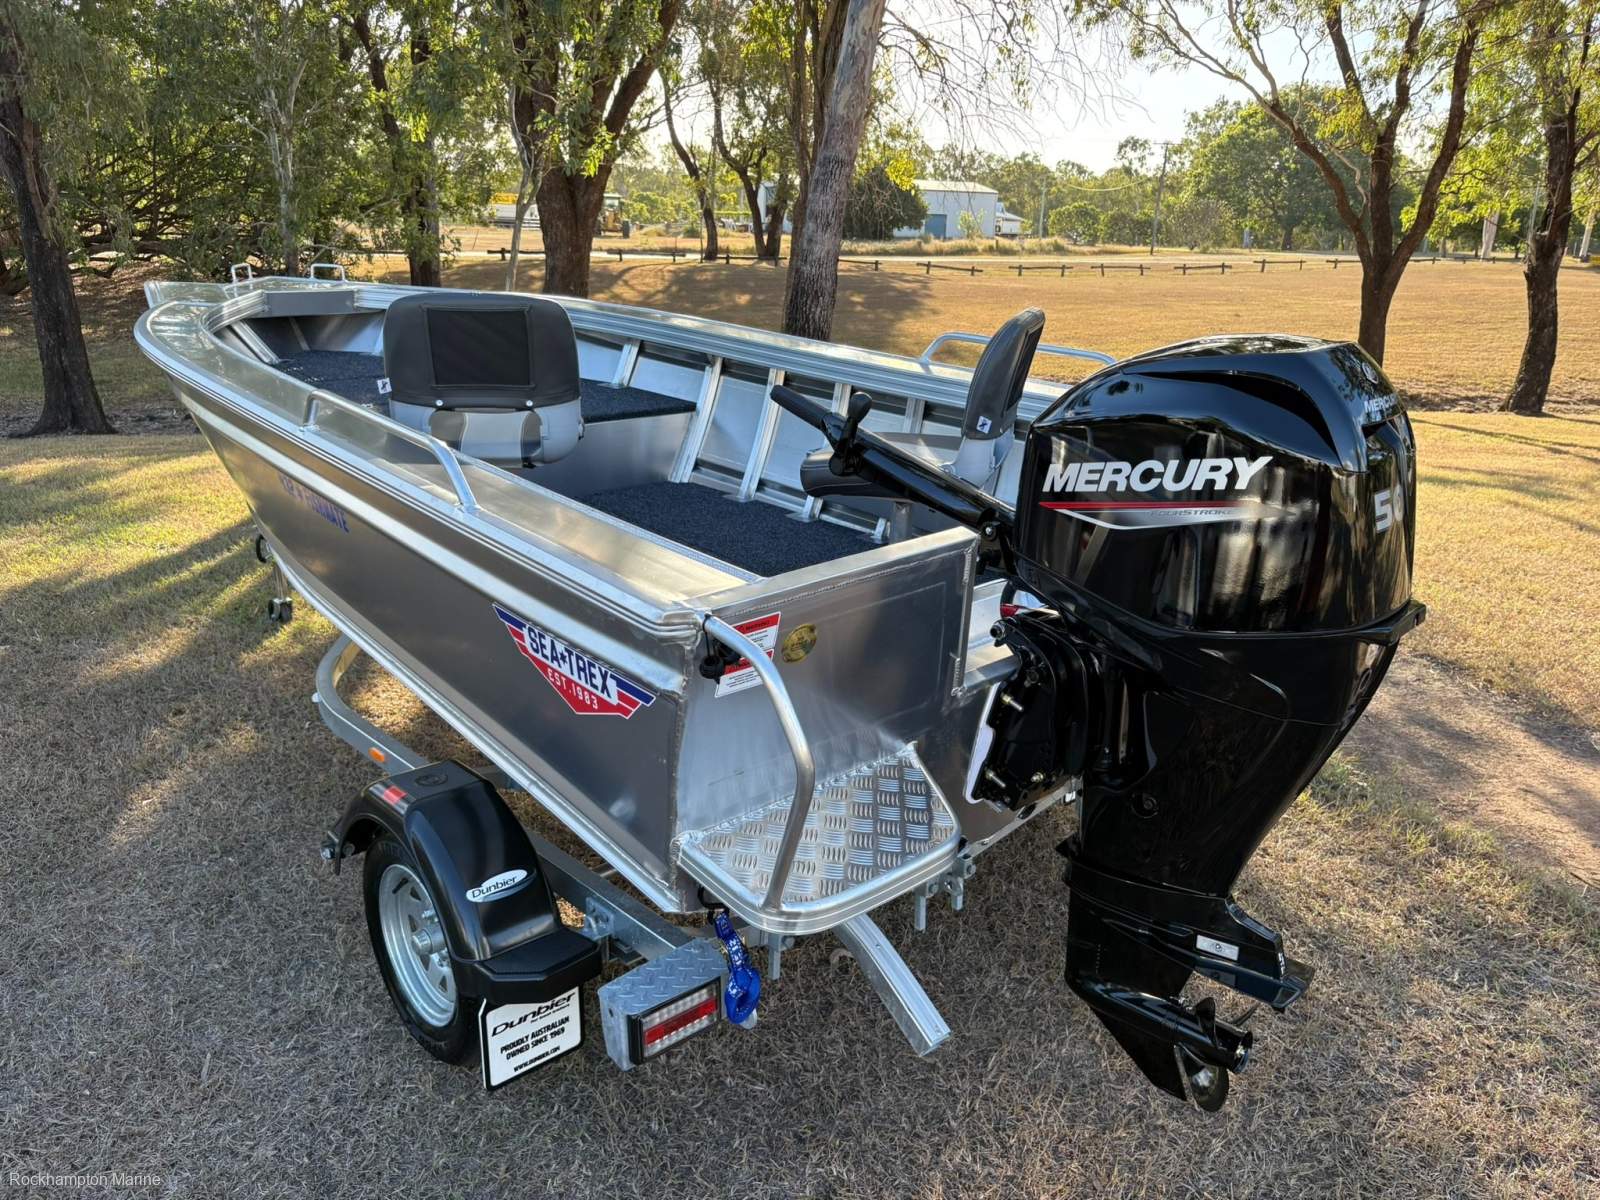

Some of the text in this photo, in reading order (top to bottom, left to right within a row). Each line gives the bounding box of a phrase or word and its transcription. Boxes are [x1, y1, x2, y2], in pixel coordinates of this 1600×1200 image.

[1042, 455, 1273, 493] MERCURY
[471, 875, 518, 898] Dunbier
[491, 991, 576, 1037] Dunbier
[500, 1016, 570, 1054] PROUDLY AUSTRALIAN
[506, 1043, 530, 1060] OWNED
[531, 1034, 548, 1048] SINCE
